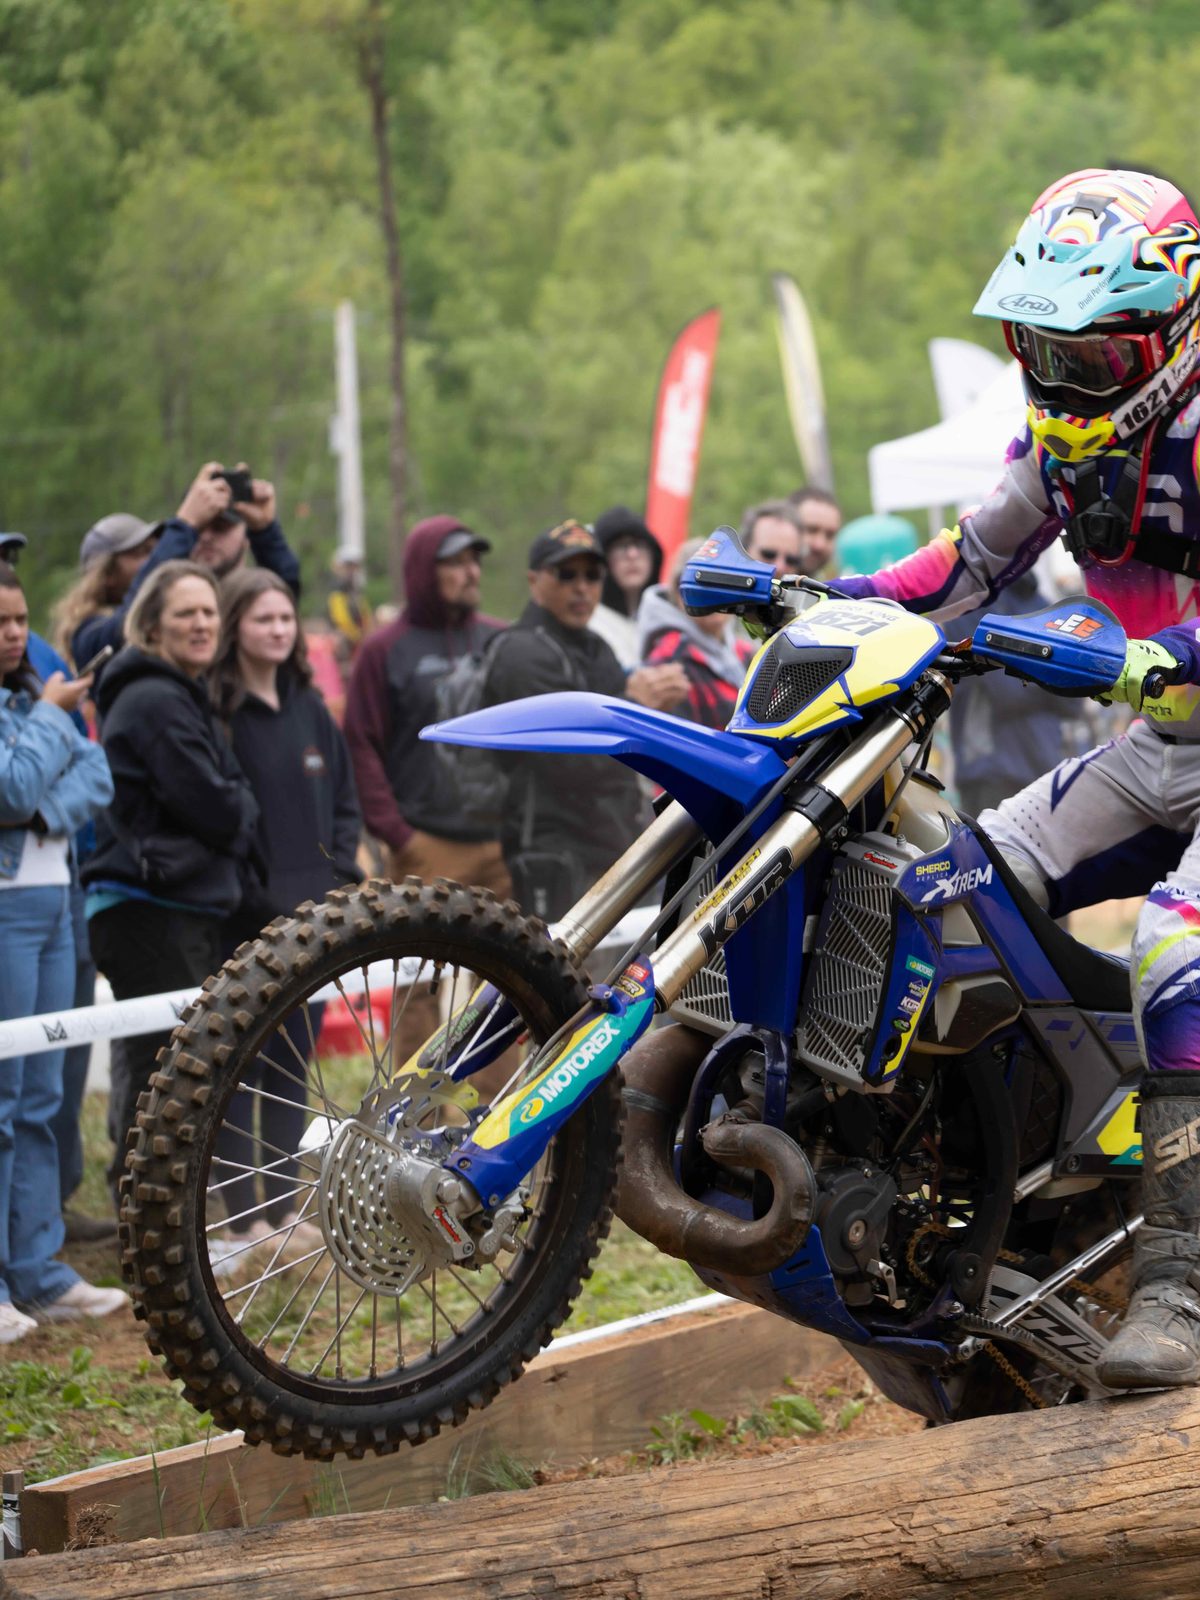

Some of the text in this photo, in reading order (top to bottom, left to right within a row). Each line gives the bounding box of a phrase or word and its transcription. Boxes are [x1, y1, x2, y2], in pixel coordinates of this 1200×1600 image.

[1003, 296, 1050, 312] Arai
[1120, 378, 1172, 431] 1621
[915, 860, 951, 876] SHERCO
[916, 871, 949, 882] REPLICA
[920, 863, 993, 903] XTREM
[537, 1020, 621, 1103] MOTOREX
